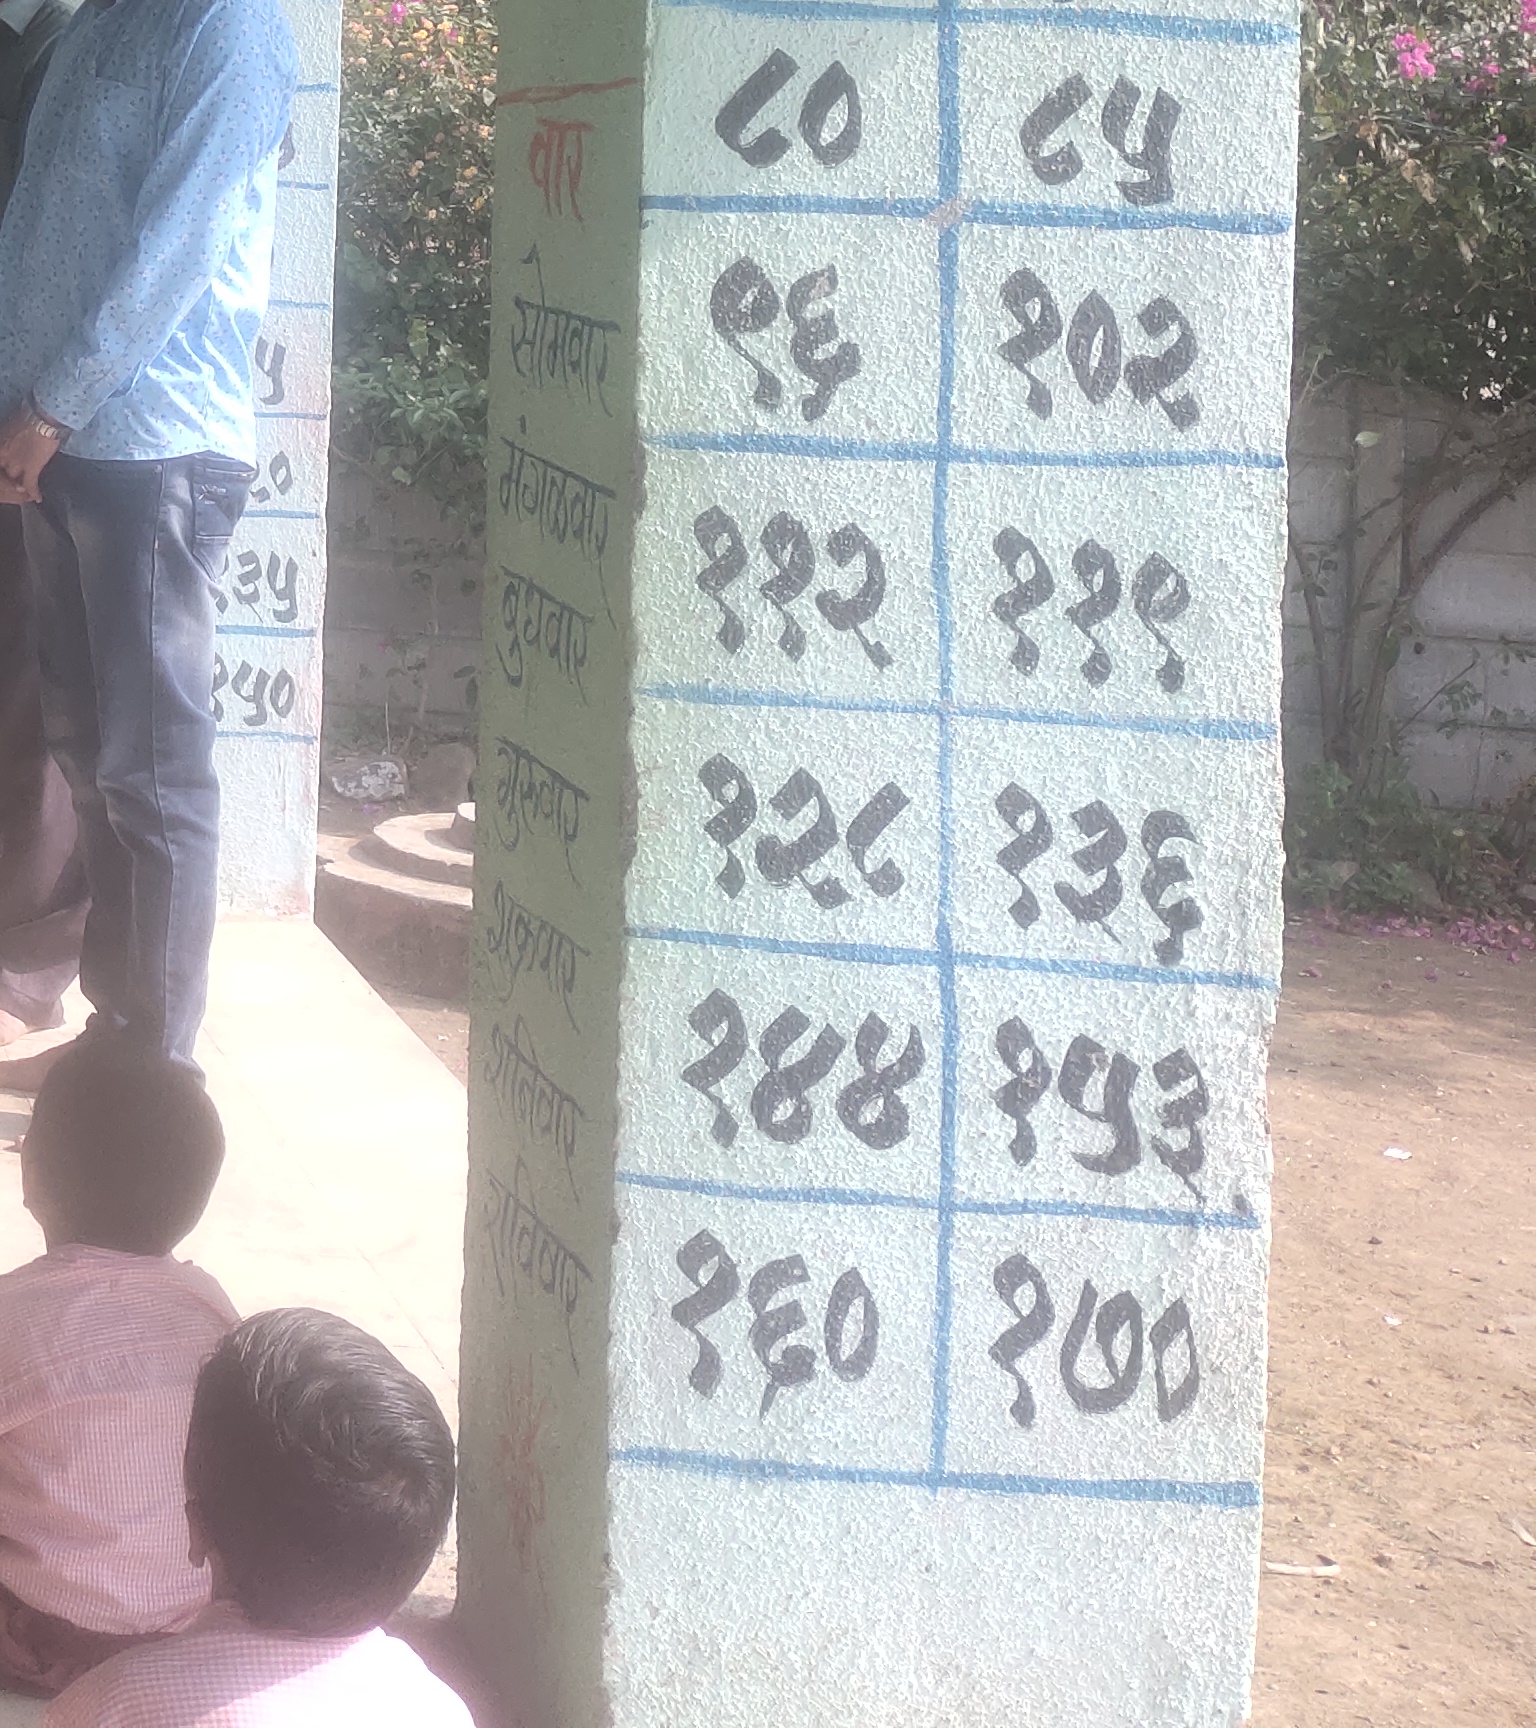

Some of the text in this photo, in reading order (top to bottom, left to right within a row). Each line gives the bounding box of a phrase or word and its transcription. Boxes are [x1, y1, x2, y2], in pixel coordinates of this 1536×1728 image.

[529, 117, 596, 223] वार
[715, 48, 1182, 206] ८० ८५
[511, 242, 621, 418] सोमवार
[710, 256, 1200, 431] ९६ १०२
[213, 550, 299, 623] ३५
[495, 565, 595, 708] बुधवार
[693, 505, 1191, 694] ११२ ११९
[697, 752, 1204, 964] १२८ १३६
[681, 987, 1210, 1201] १४४ १५३
[671, 1228, 1200, 1429] १६० १७०
